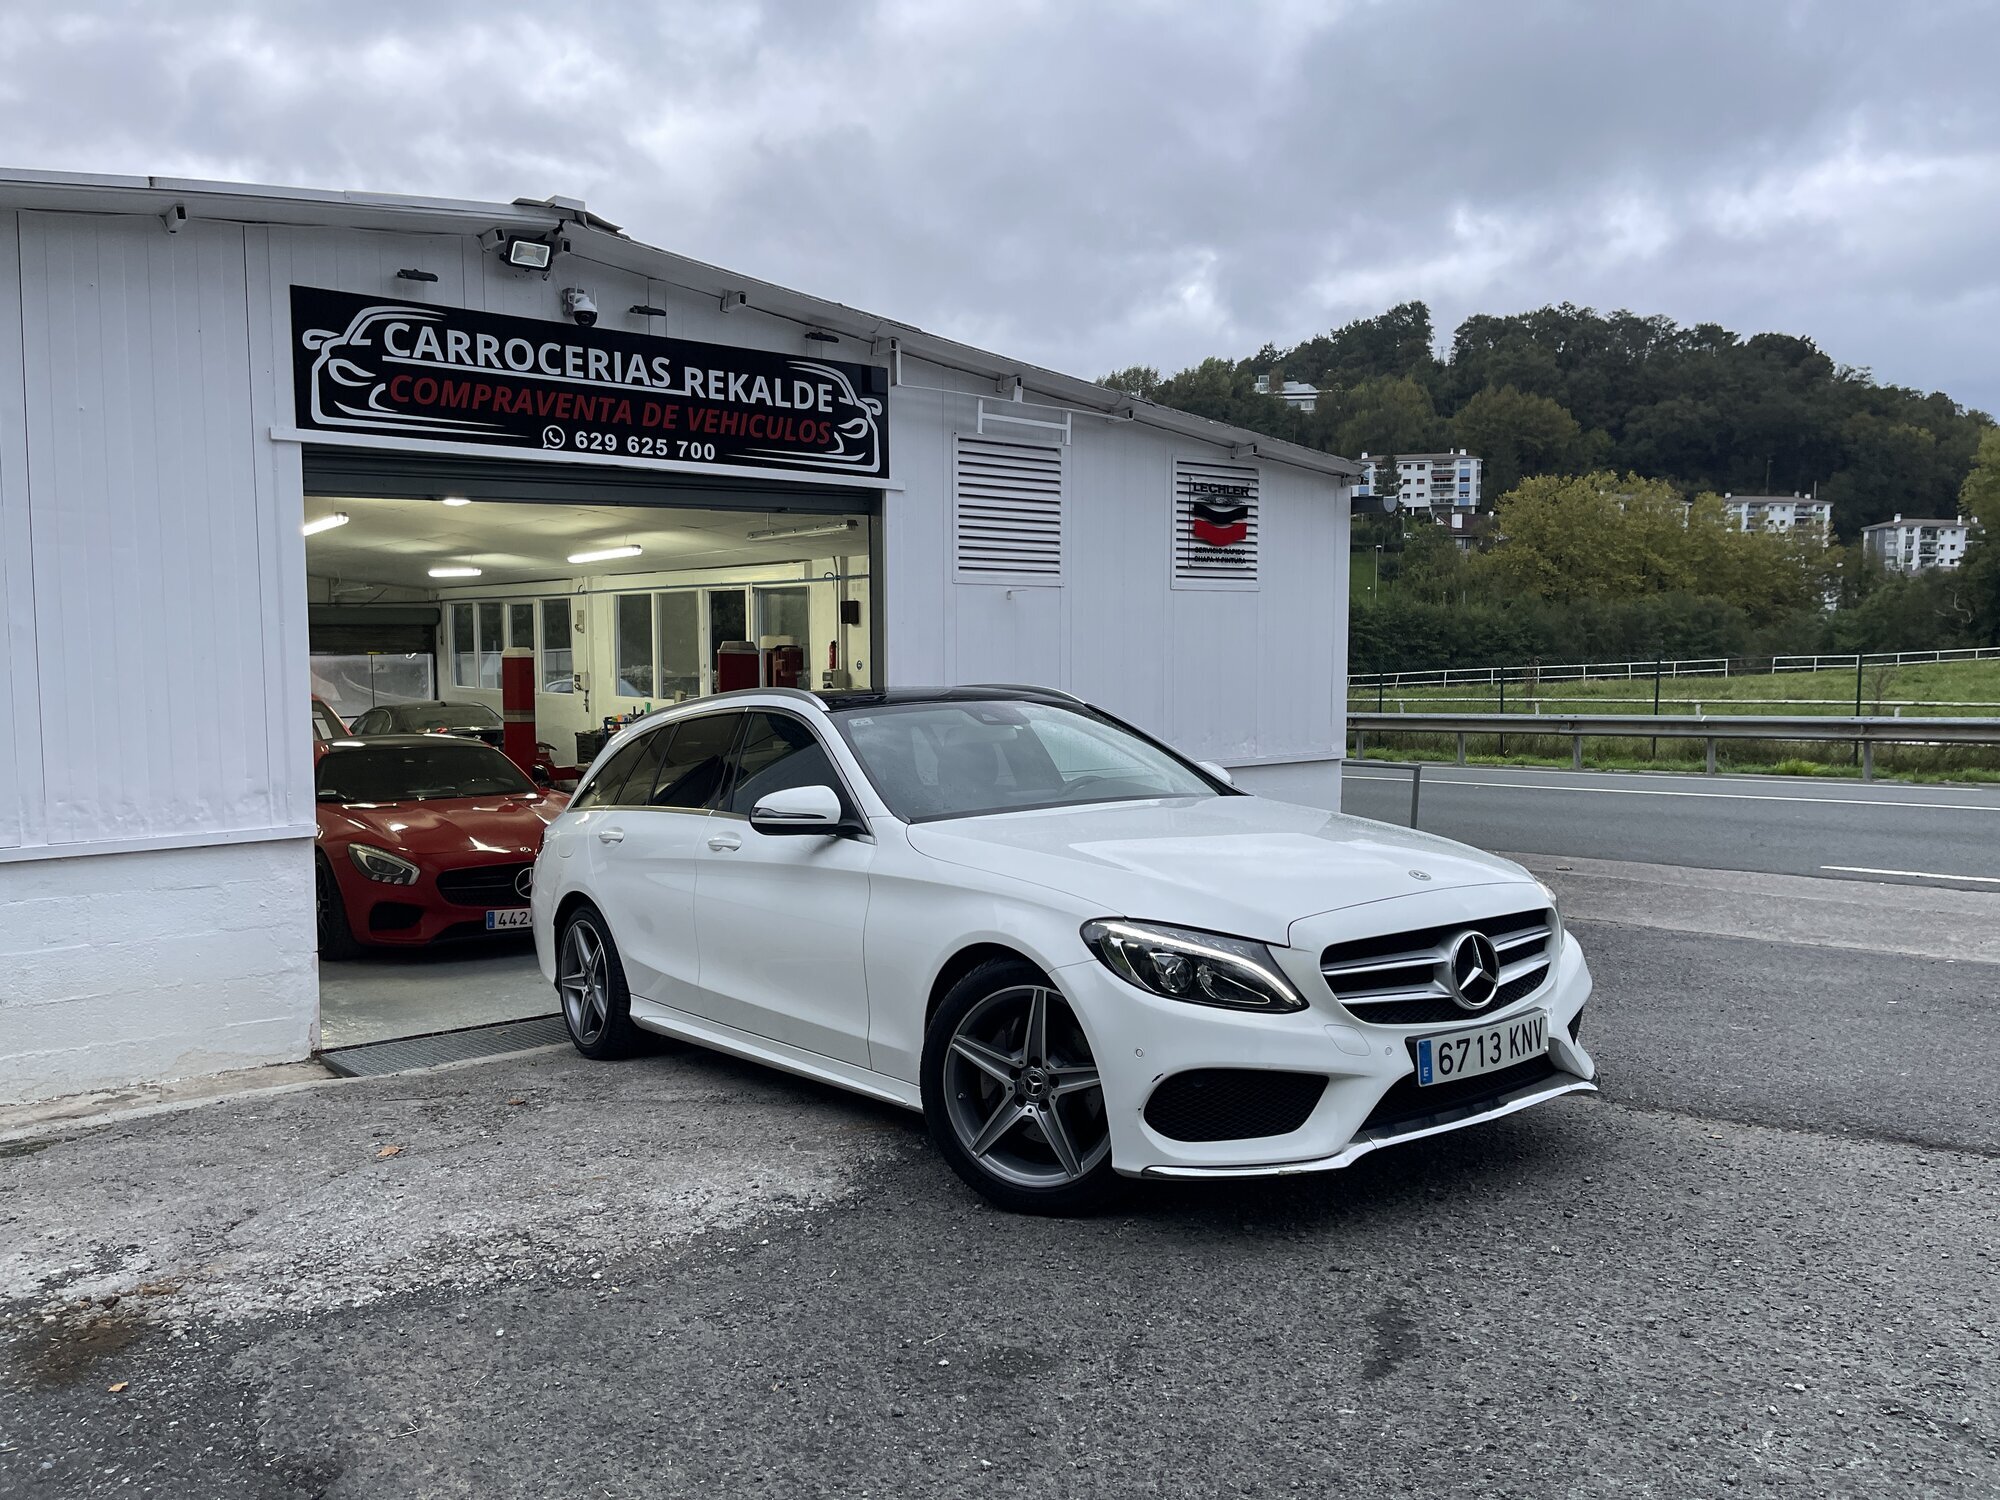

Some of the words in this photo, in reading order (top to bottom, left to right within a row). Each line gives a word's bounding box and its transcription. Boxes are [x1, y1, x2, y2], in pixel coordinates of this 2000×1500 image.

[383, 321, 672, 388] CARROCERIAS
[684, 366, 833, 413] REKALDE
[390, 374, 633, 426] COMPRAVENTA
[642, 402, 680, 430] DE
[687, 406, 832, 445] VEHICULOS
[574, 430, 618, 452] 629
[626, 435, 668, 456] 625
[676, 440, 716, 461] 700
[1193, 482, 1250, 497] LECHLER
[1423, 1066, 1429, 1077] E
[1438, 1032, 1501, 1076] 6713
[1509, 1017, 1543, 1059] KNV
